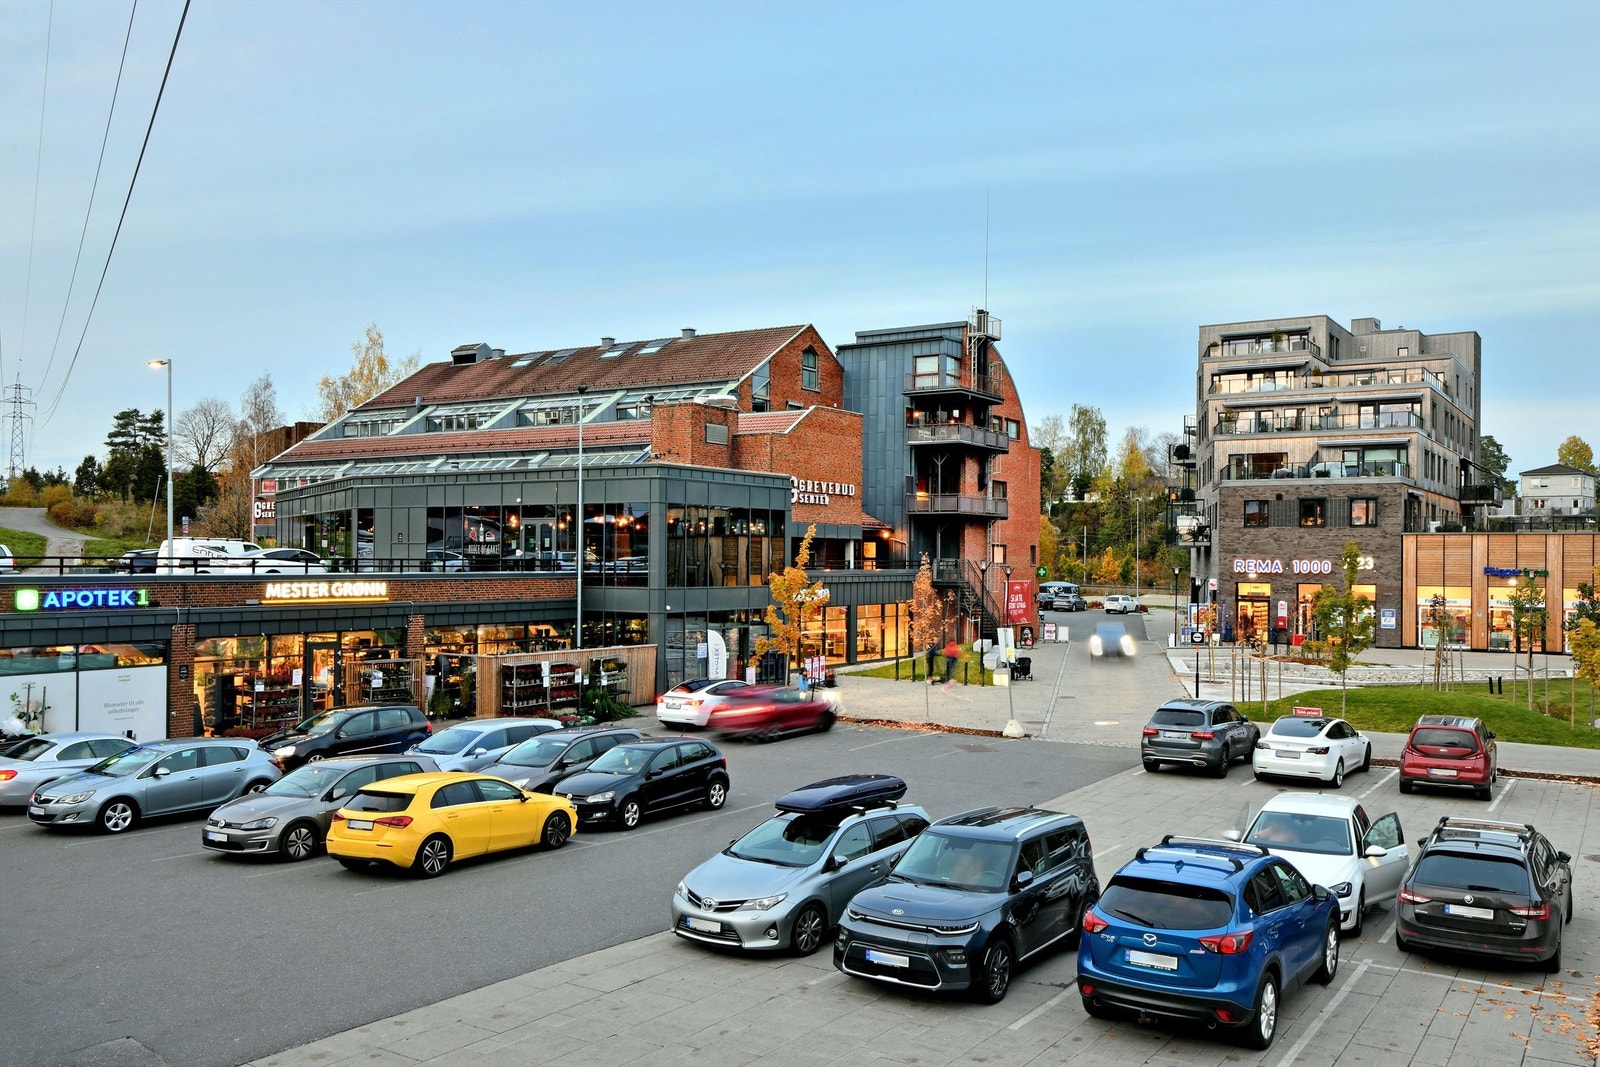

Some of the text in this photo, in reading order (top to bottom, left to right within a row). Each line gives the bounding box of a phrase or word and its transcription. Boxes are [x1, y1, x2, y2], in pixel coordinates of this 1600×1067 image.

[799, 479, 855, 496] GREVERUD
[799, 493, 829, 505] SENTER
[1234, 560, 1332, 574] REMA 1000
[43, 589, 149, 608] APOTEK 1
[265, 581, 387, 599] MESTER GRØNN
